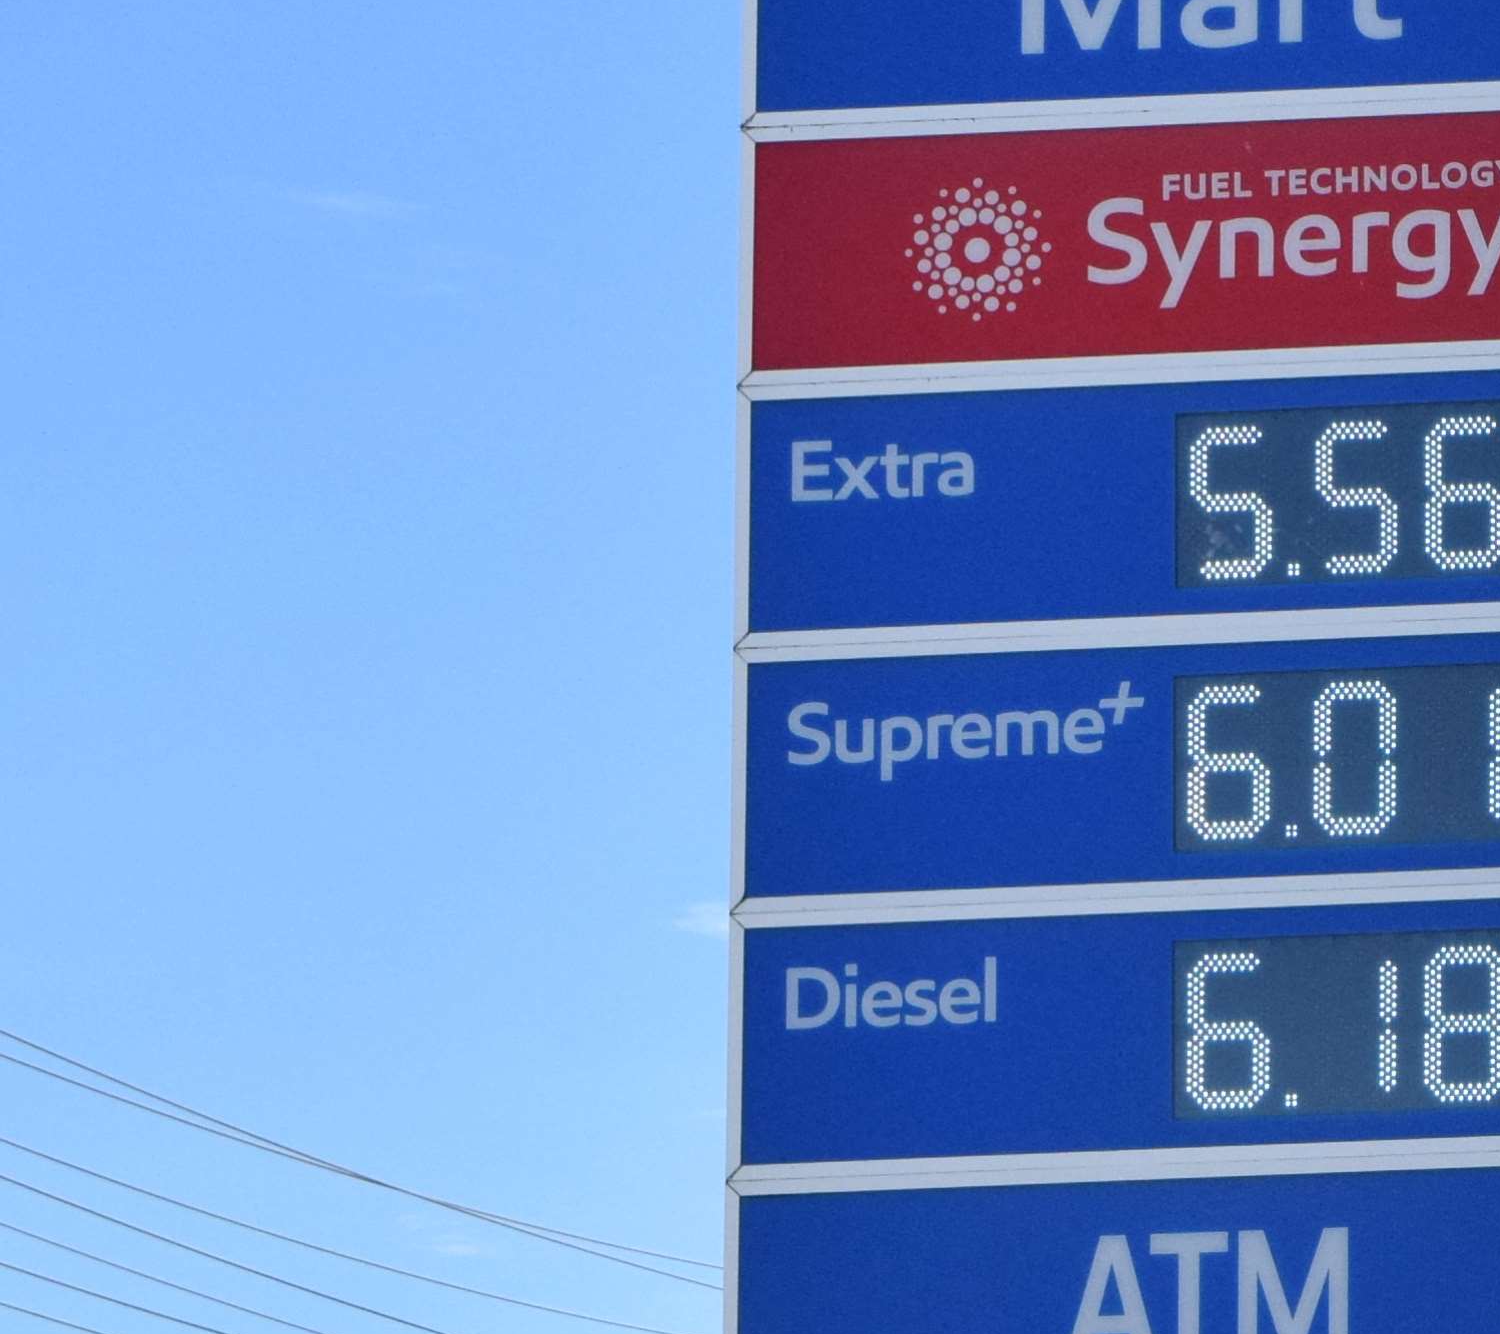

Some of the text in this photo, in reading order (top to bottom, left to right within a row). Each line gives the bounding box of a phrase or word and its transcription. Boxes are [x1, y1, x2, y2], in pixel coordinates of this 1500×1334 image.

[1162, 171, 1253, 202] FUEL
[790, 439, 976, 503] Extra
[785, 955, 997, 1030] Diesel
